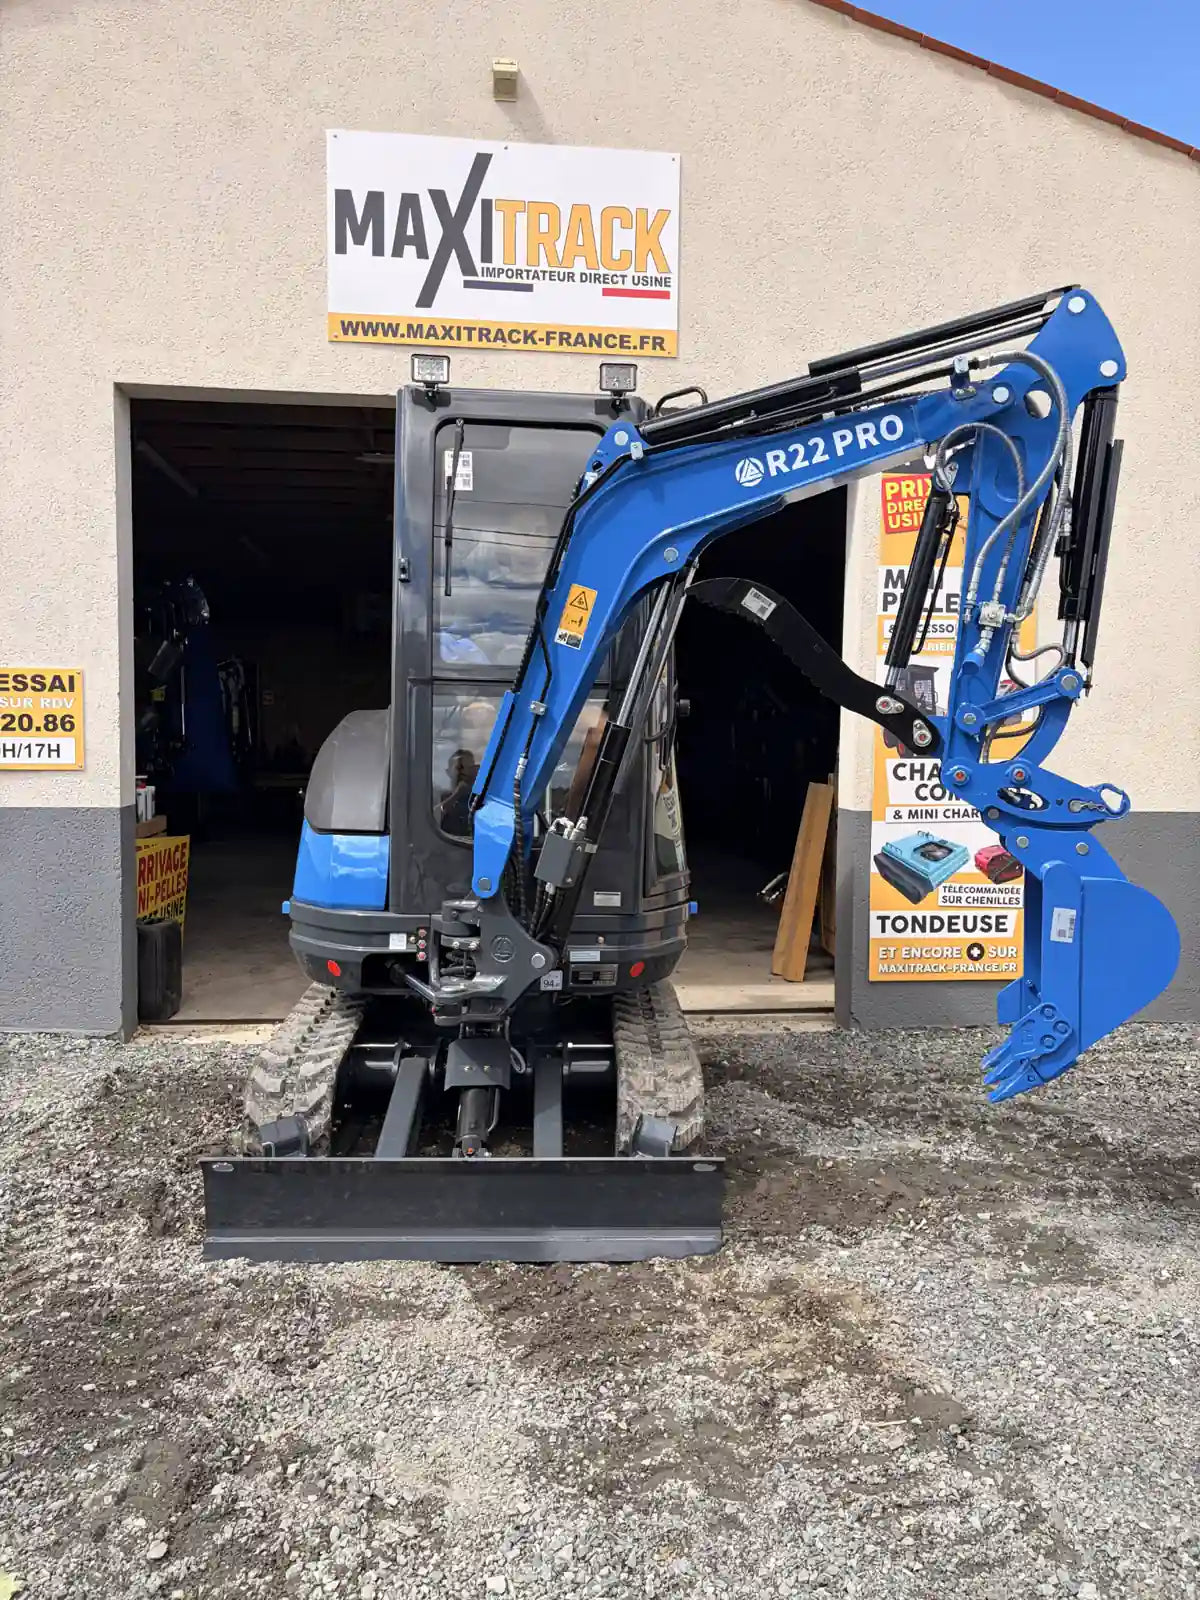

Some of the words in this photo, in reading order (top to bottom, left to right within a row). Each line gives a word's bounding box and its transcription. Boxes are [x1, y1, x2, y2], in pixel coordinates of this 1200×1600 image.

[334, 152, 672, 308] MAXITRACK
[481, 266, 576, 283] IMPORTATEUR
[579, 271, 627, 285] DIRECT
[632, 275, 672, 288] USINE
[340, 319, 666, 351] WWW.MAXITRACK-FRANCE.FR
[766, 436, 829, 477] R22
[832, 414, 904, 457] PRO
[40, 698, 74, 709] RDV
[1, 713, 75, 732] 20.86
[893, 809, 903, 820] &
[908, 809, 938, 820] MINI
[942, 884, 1021, 895] TÉLÉCOMMANDÉE
[942, 895, 962, 904] SUR
[965, 896, 1021, 905] CHENILLES
[876, 915, 1008, 934] TONDEUSE
[879, 947, 897, 959] ET
[902, 946, 962, 958] ENCORE
[988, 946, 1017, 958] SUR
[878, 962, 1017, 974] MAXITRACK-FRANCE.FR
